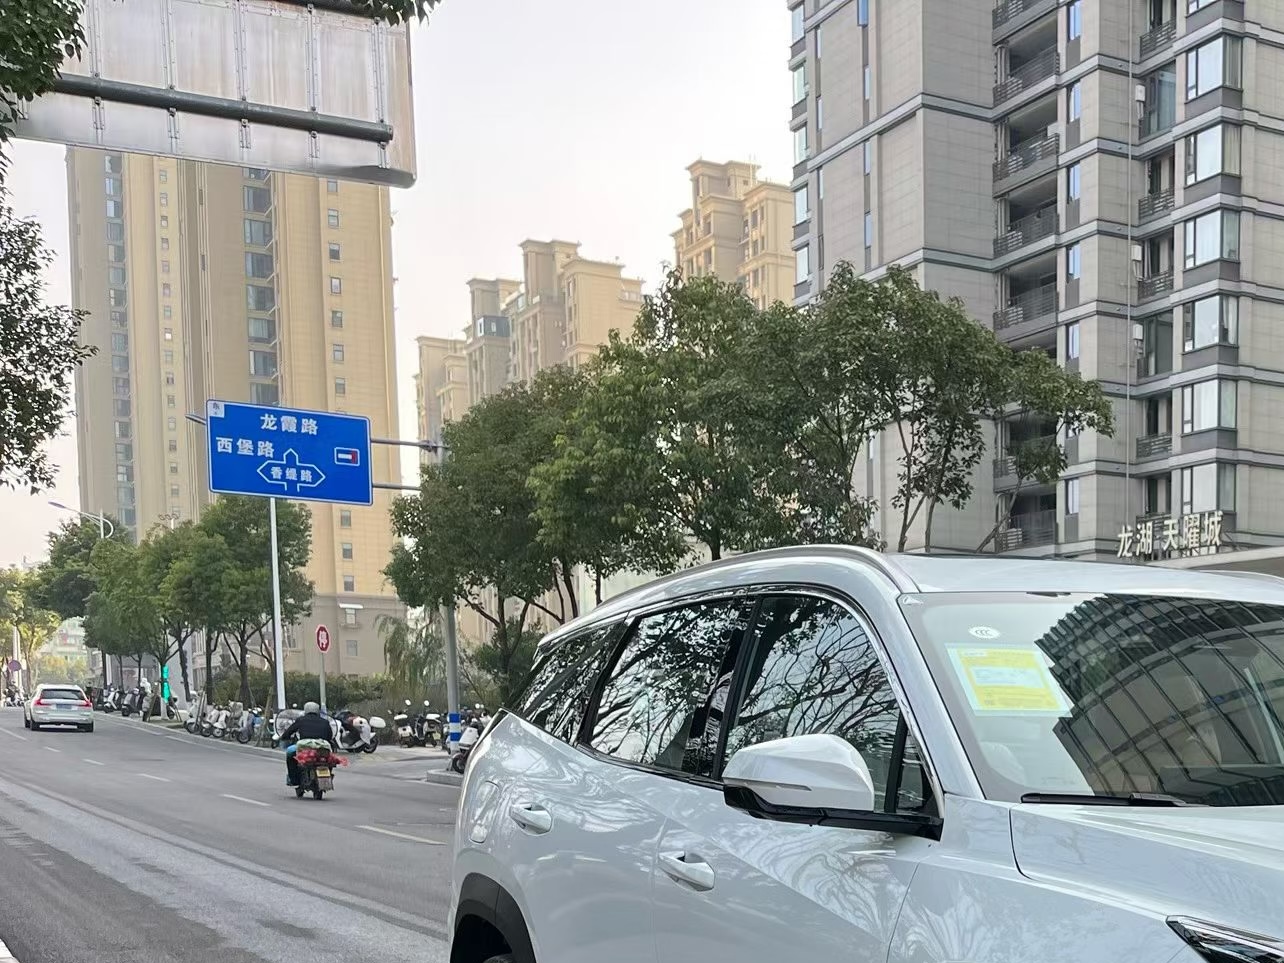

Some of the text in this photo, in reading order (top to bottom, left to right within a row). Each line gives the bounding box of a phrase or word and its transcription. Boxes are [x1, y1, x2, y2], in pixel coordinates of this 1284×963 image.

[260, 413, 319, 435] 龙霞路
[216, 436, 275, 458] 西堡路
